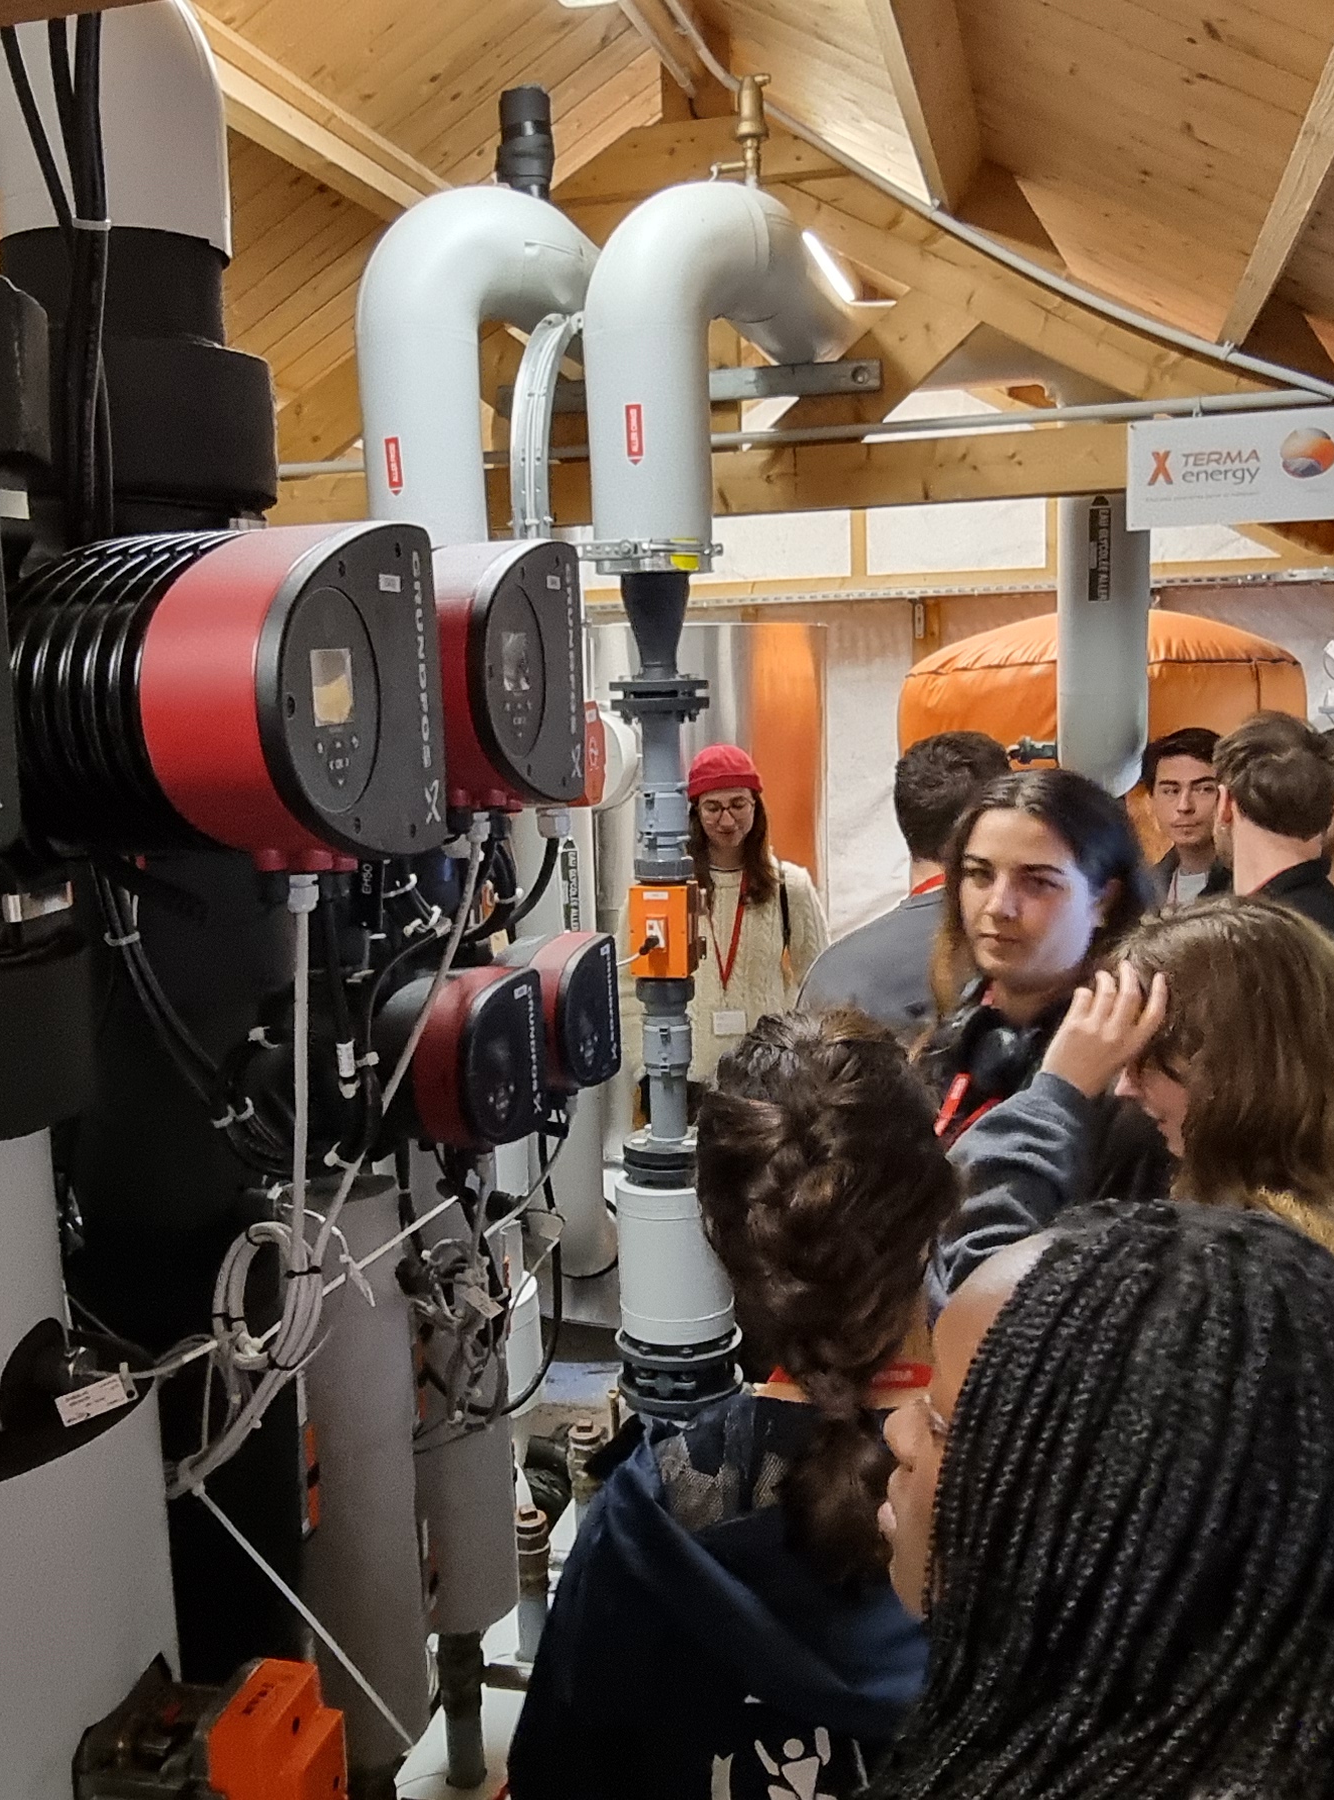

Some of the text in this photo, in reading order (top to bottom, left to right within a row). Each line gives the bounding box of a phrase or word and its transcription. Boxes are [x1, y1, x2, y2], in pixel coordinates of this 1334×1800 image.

[1181, 448, 1261, 468] TERMA
[1181, 466, 1261, 486] energy
[1097, 573, 1110, 600] ALLER
[412, 551, 432, 768] GRUNDFOS
